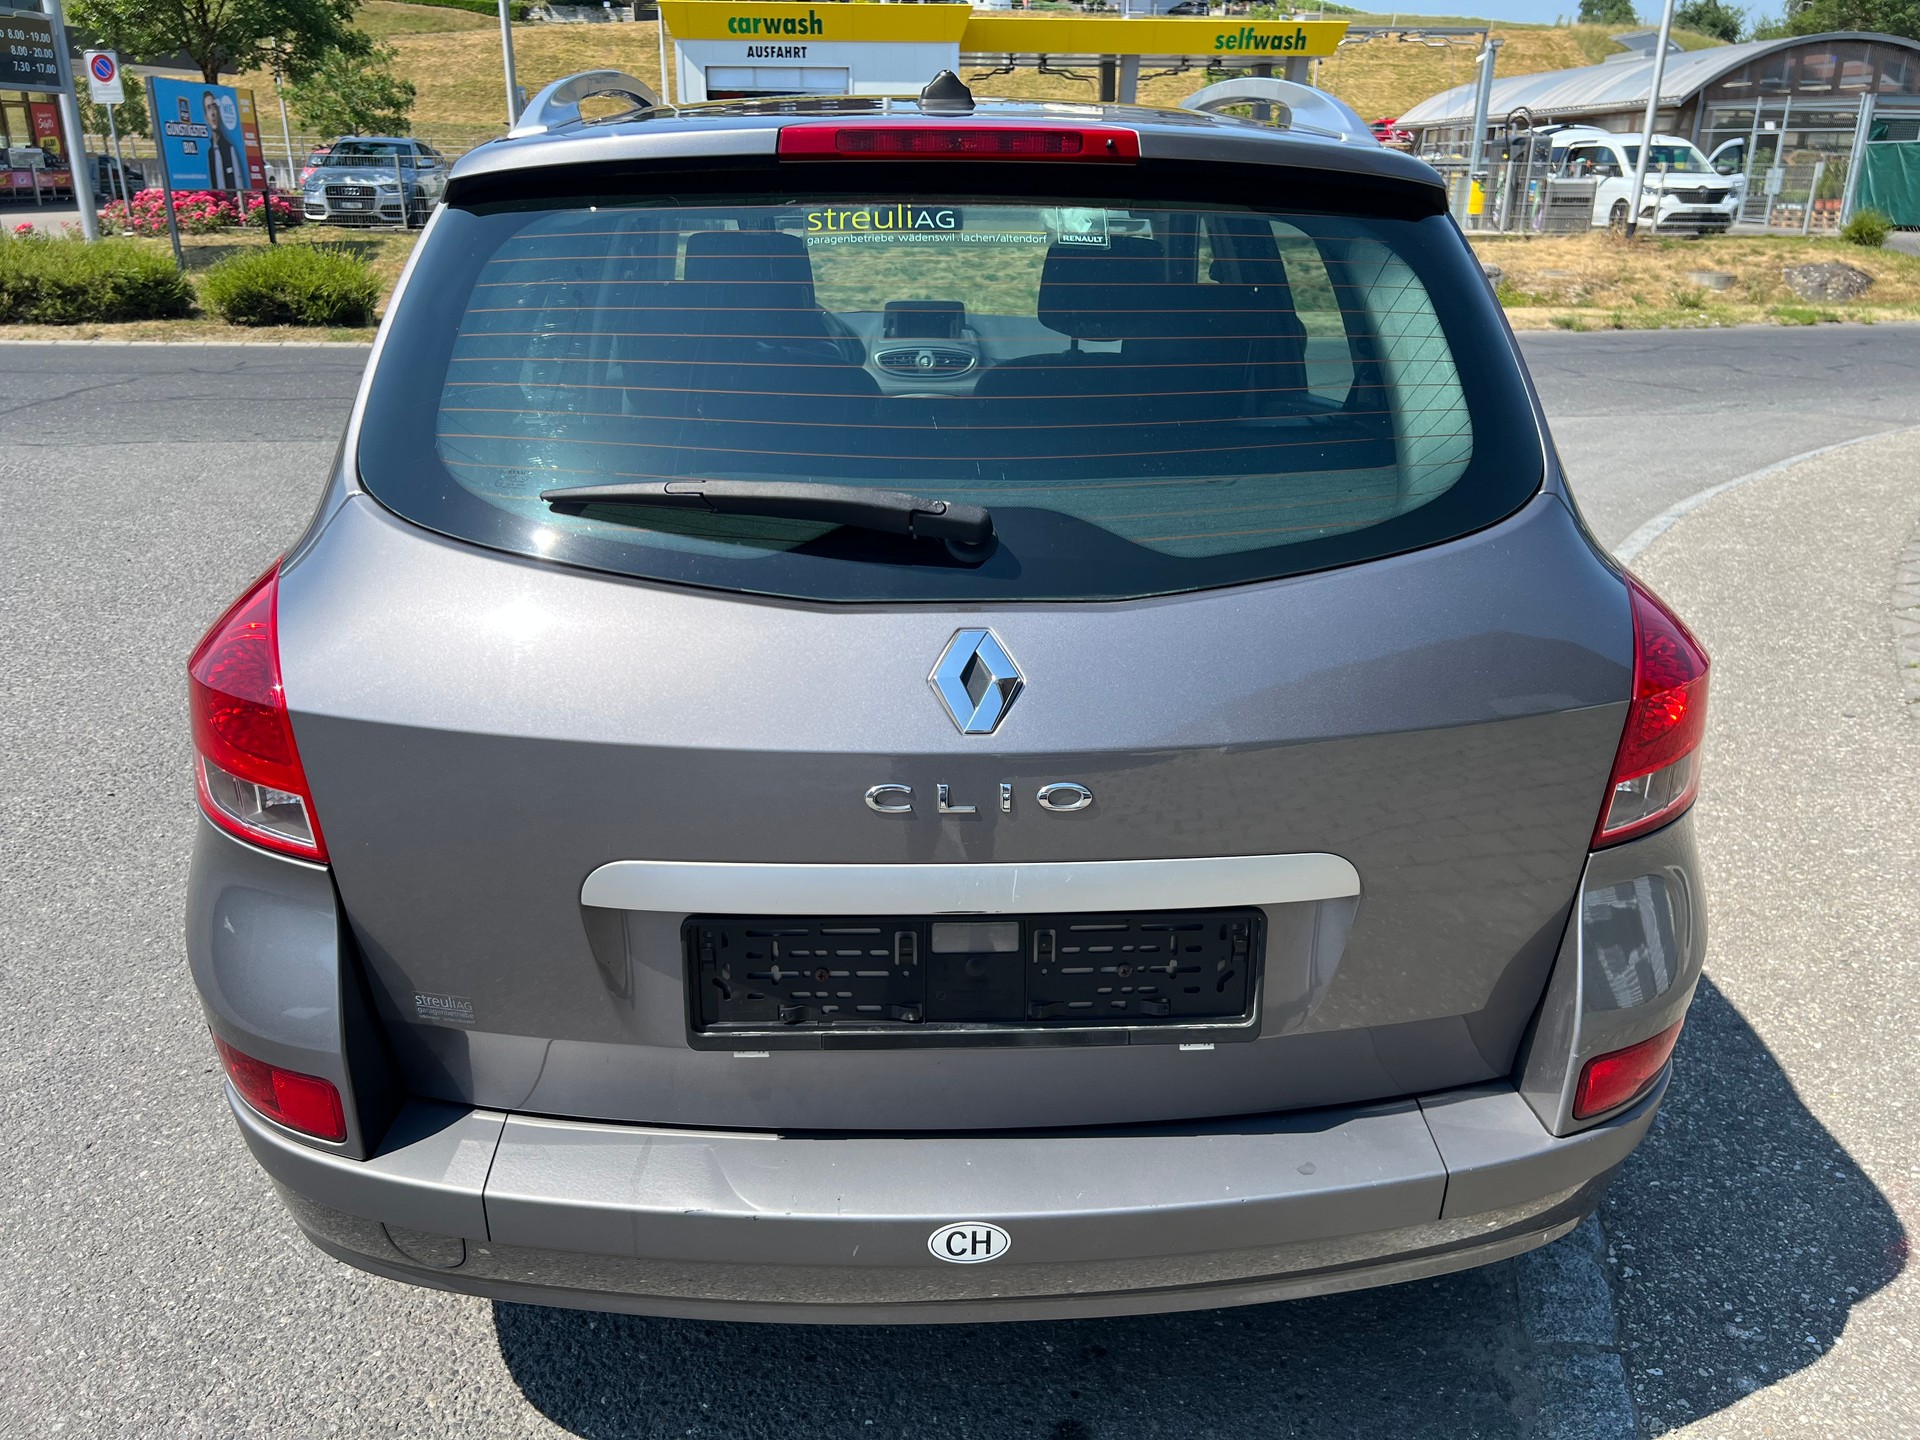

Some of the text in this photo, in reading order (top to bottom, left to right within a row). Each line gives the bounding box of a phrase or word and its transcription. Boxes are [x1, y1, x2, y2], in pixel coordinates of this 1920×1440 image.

[728, 10, 823, 34] carwash
[7, 29, 25, 40] 8.00
[30, 32, 51, 43] 19.00
[1214, 27, 1307, 50] selfwash
[10, 45, 28, 56] 8.00
[33, 48, 53, 58] 20.00
[747, 46, 807, 58] AUSFAHRT
[13, 61, 31, 72] 7.30
[36, 64, 57, 74] 17.00
[807, 234, 894, 246] garagenbetriebe
[1062, 235, 1104, 243] RENAULT
[865, 782, 1093, 813] CLIO
[946, 1230, 991, 1256] CH
